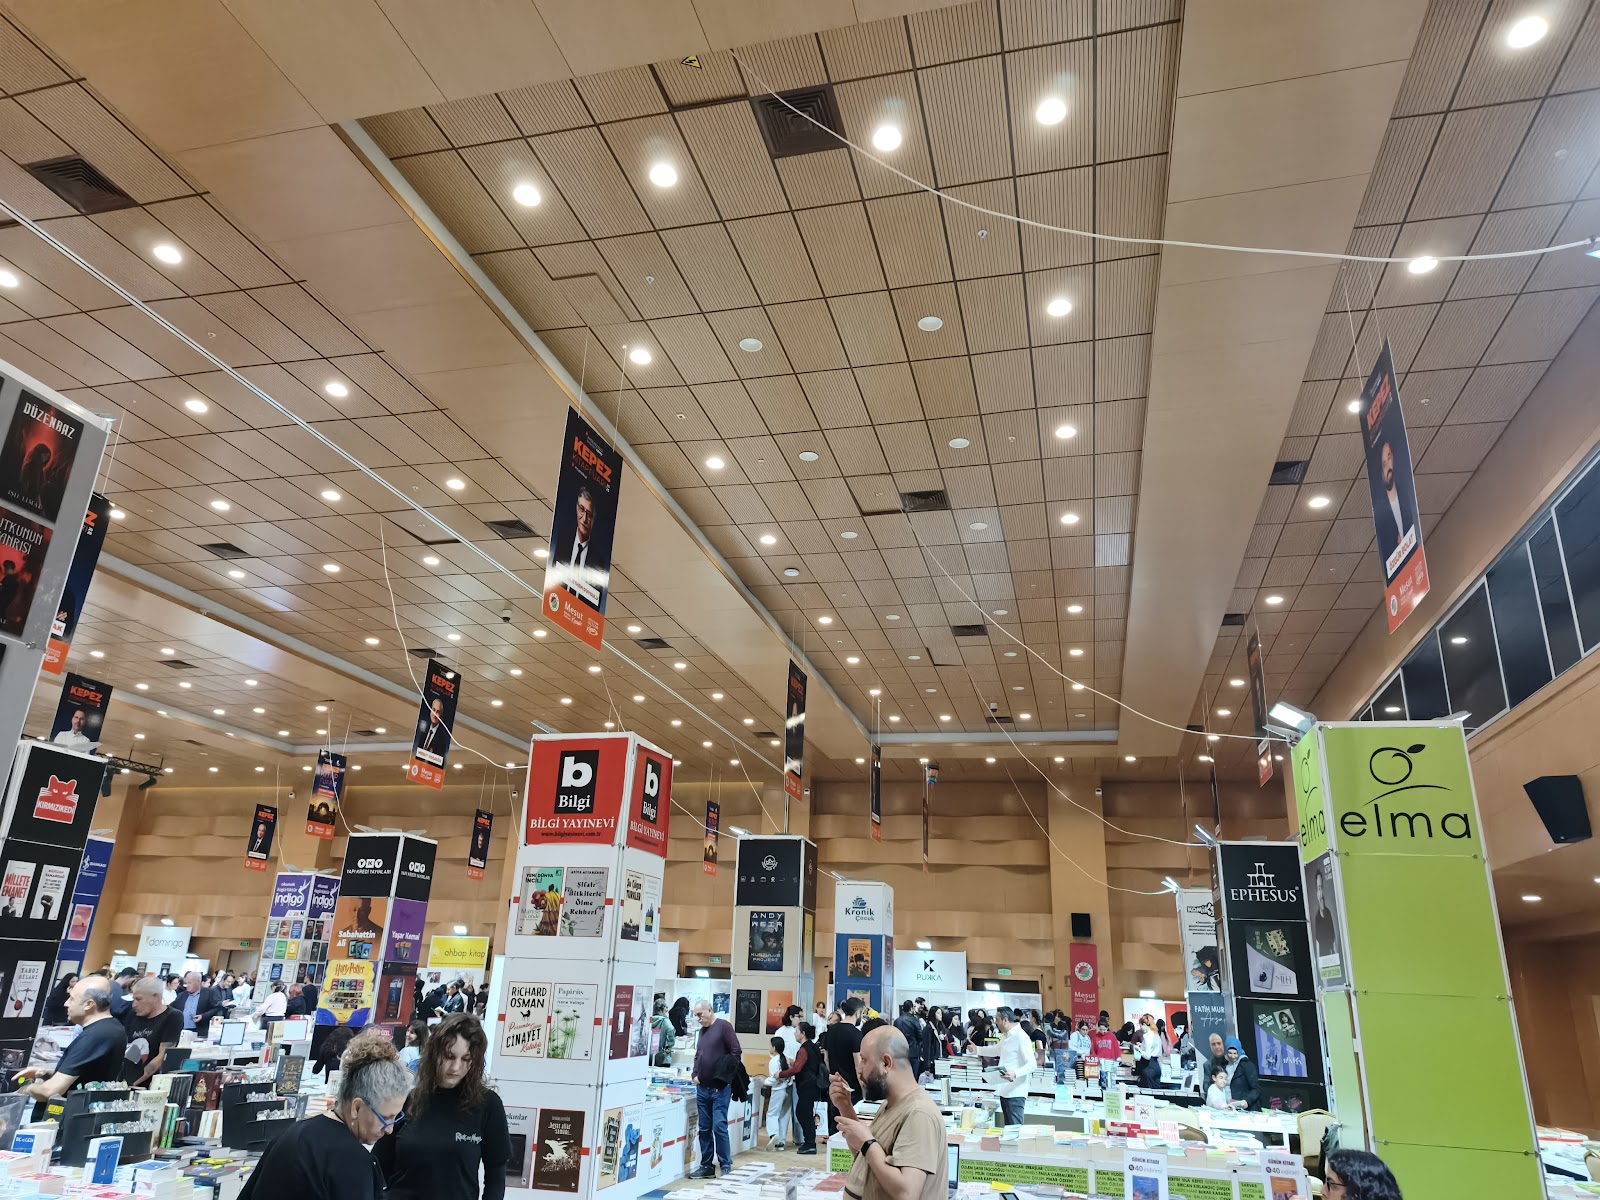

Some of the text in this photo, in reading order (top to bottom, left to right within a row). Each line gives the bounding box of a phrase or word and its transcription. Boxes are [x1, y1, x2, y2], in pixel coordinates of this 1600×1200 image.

[23, 401, 76, 439] DÜZENBAZ
[573, 436, 612, 483] KEPEZ
[564, 601, 583, 620] Mesut
[430, 673, 455, 693] KEPEZ
[70, 685, 103, 702] KEPEZ
[37, 801, 76, 814] KIRMIZIKEDİ
[558, 795, 591, 811] Bilgi
[642, 801, 657, 820] Bilgi
[530, 817, 615, 829] BİLGİ YAYINEVİ
[1301, 809, 1326, 847] elma
[1340, 804, 1471, 839] elma
[630, 821, 665, 841] BİLGİ YAYINEVİ
[5, 873, 31, 887] MİLLETE
[1, 886, 28, 899] EMANET
[1231, 888, 1297, 902] EPHESUS
[275, 893, 304, 907] indigo
[312, 894, 334, 909] indigo
[575, 898, 593, 906] Ölme
[845, 907, 875, 916] Kronik
[338, 930, 376, 939] Sabahattin
[391, 931, 420, 940] Yaşar Kemal
[149, 937, 184, 950] domingo
[336, 939, 347, 947] Ali
[444, 948, 486, 959] ahbap kitap
[335, 963, 350, 976] Harry
[916, 973, 943, 982] PUKKA
[558, 987, 584, 996] Papirüs
[1074, 991, 1096, 999] Mesut
[510, 998, 545, 1008] OSMAN
[1194, 1004, 1210, 1013] FATİH
[506, 1028, 541, 1048] CİNAYET
